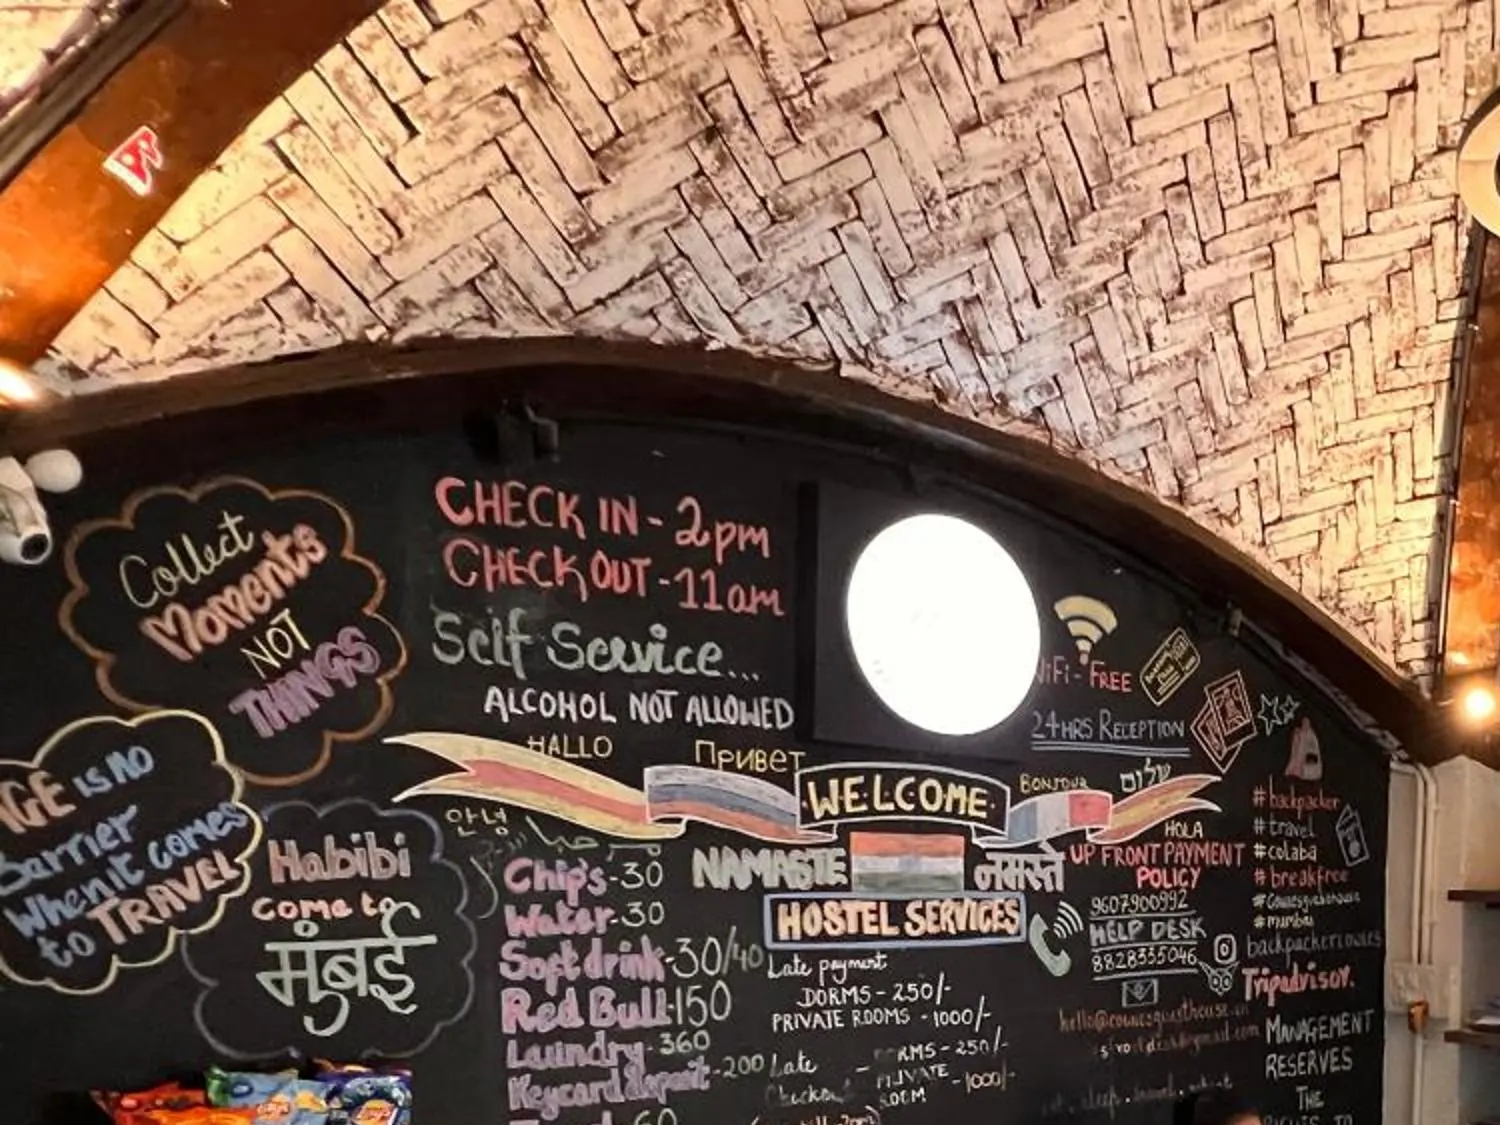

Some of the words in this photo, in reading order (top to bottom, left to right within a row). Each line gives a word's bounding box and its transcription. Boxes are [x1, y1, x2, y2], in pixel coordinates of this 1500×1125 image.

[435, 476, 587, 540] CHECK
[598, 496, 639, 536] IN
[675, 496, 770, 564] 2pm
[119, 511, 254, 608] Collect
[443, 538, 588, 602] CHECK
[590, 550, 652, 597] OUT
[137, 523, 327, 662] Moments
[240, 608, 311, 679] NOT
[431, 605, 533, 680] Self
[228, 625, 382, 738] THINGS
[1089, 660, 1133, 693] FREE
[484, 686, 617, 724] ALCOHOL
[629, 690, 678, 723] NOT
[686, 694, 795, 730] ALLOWED
[1099, 709, 1186, 742] RECEPTION
[105, 744, 154, 784] NO
[527, 735, 613, 759] HALLO
[695, 739, 806, 773] Привет
[804, 774, 989, 821] WELCOME
[147, 801, 249, 870] comes
[445, 808, 510, 838] 안녕
[1164, 820, 1204, 840] HOLA
[267, 832, 412, 885] Habibi
[691, 846, 848, 891] NAMASTE
[1068, 844, 1096, 866] UP
[1101, 843, 1159, 867] FRONT
[1163, 841, 1246, 867] PAYMENT
[1136, 867, 1201, 892] POLICY
[36, 931, 96, 968] to
[86, 849, 242, 946] TRAVEL
[504, 900, 616, 939] Water
[778, 898, 899, 940] HOSTEL
[904, 898, 1020, 938] SERVICES
[1089, 919, 1142, 947] HELP
[1151, 915, 1207, 941] DESK
[255, 900, 437, 1037] मुंबई
[500, 939, 581, 996] Soft
[583, 934, 667, 983] drink
[767, 951, 814, 980] Late
[500, 987, 584, 1036] Red
[589, 985, 670, 1030] Bull
[797, 984, 872, 1008] DORMS
[771, 1009, 846, 1033] PRIVATE
[1265, 1008, 1375, 1046] MANAGEMENT
[505, 1030, 648, 1072] Laundry
[770, 1049, 818, 1079] Late
[1265, 1048, 1353, 1081] RESERVES
[1296, 1085, 1325, 1110] THE
